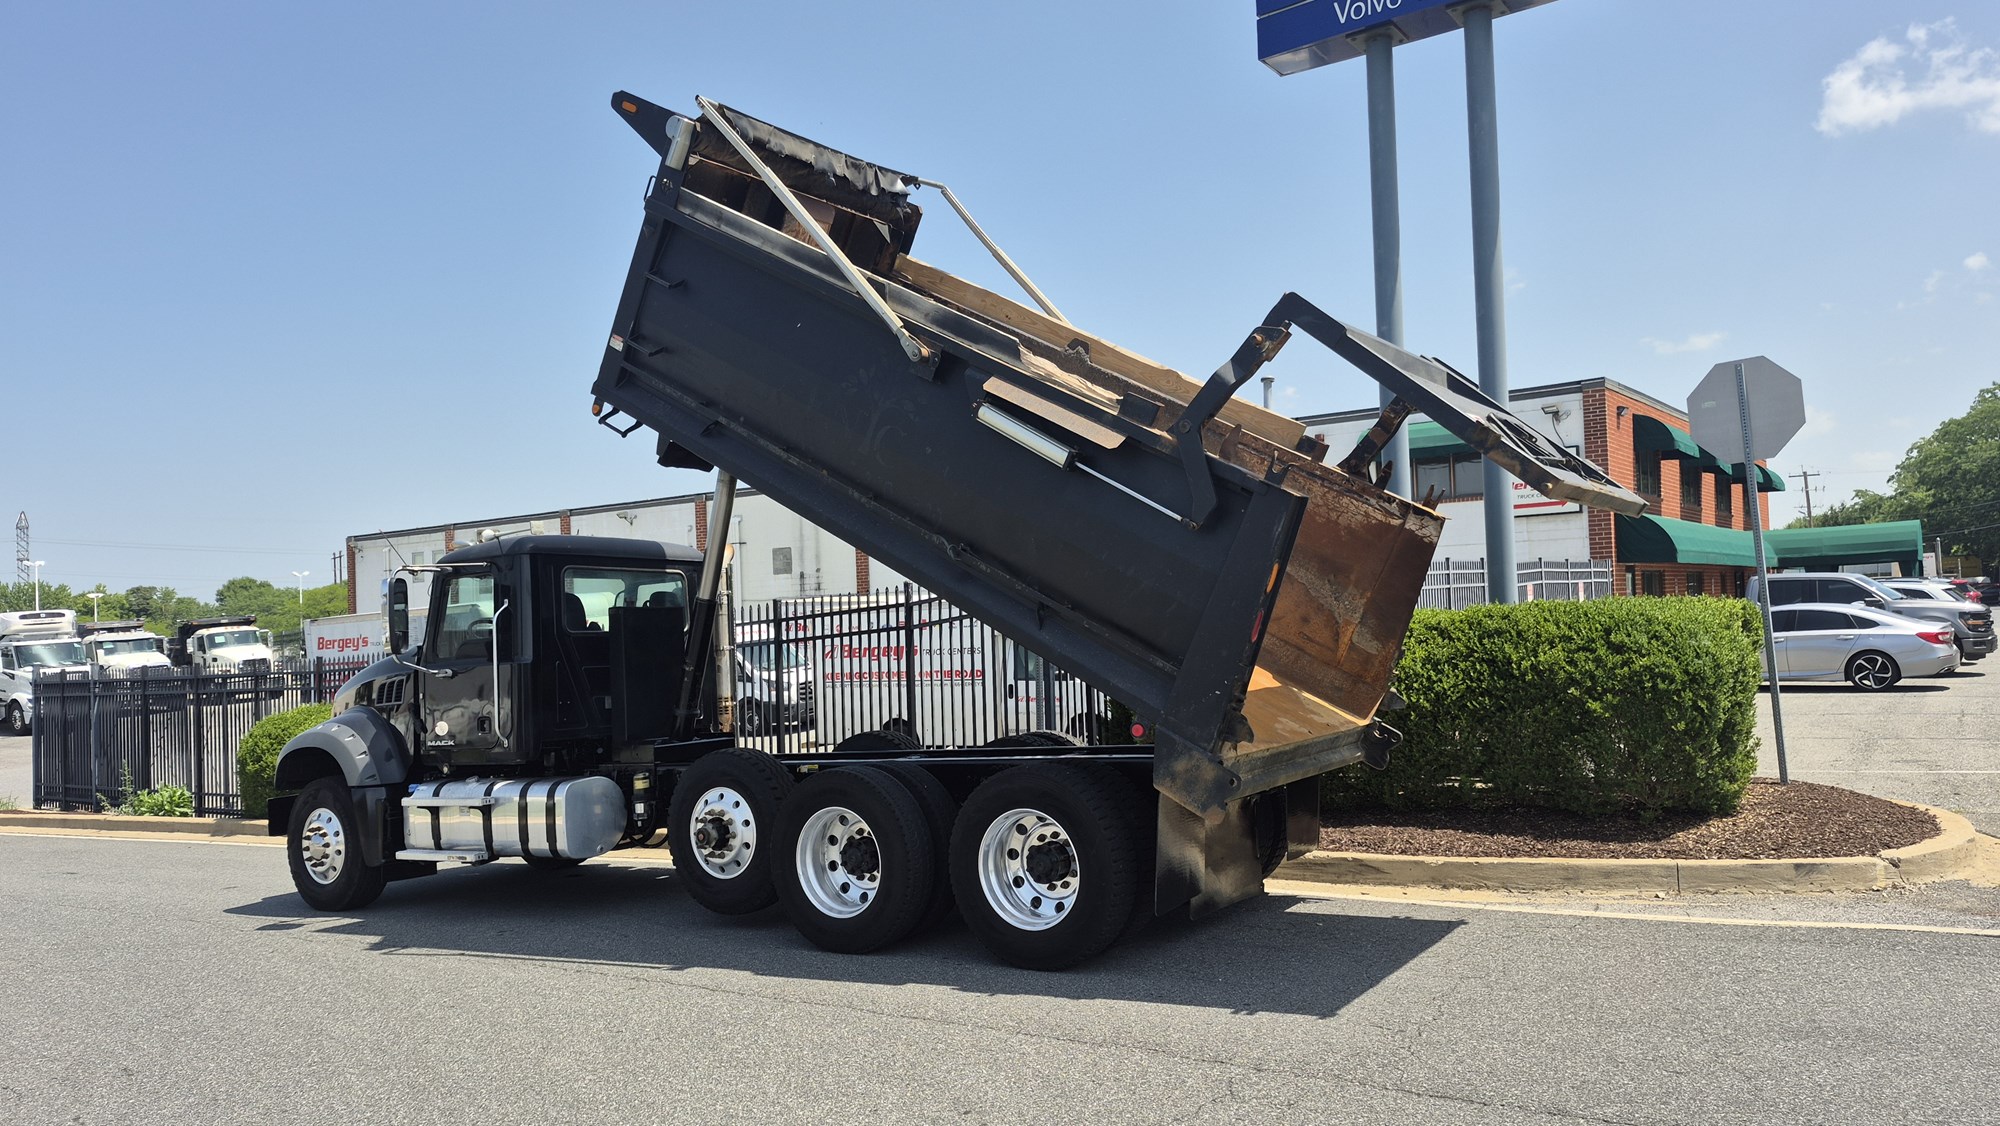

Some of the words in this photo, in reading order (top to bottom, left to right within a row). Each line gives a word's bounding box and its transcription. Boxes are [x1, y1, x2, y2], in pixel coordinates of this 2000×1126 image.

[317, 635, 369, 652] Bergey's
[842, 644, 919, 661] Bergeys
[825, 672, 861, 681] KEING
